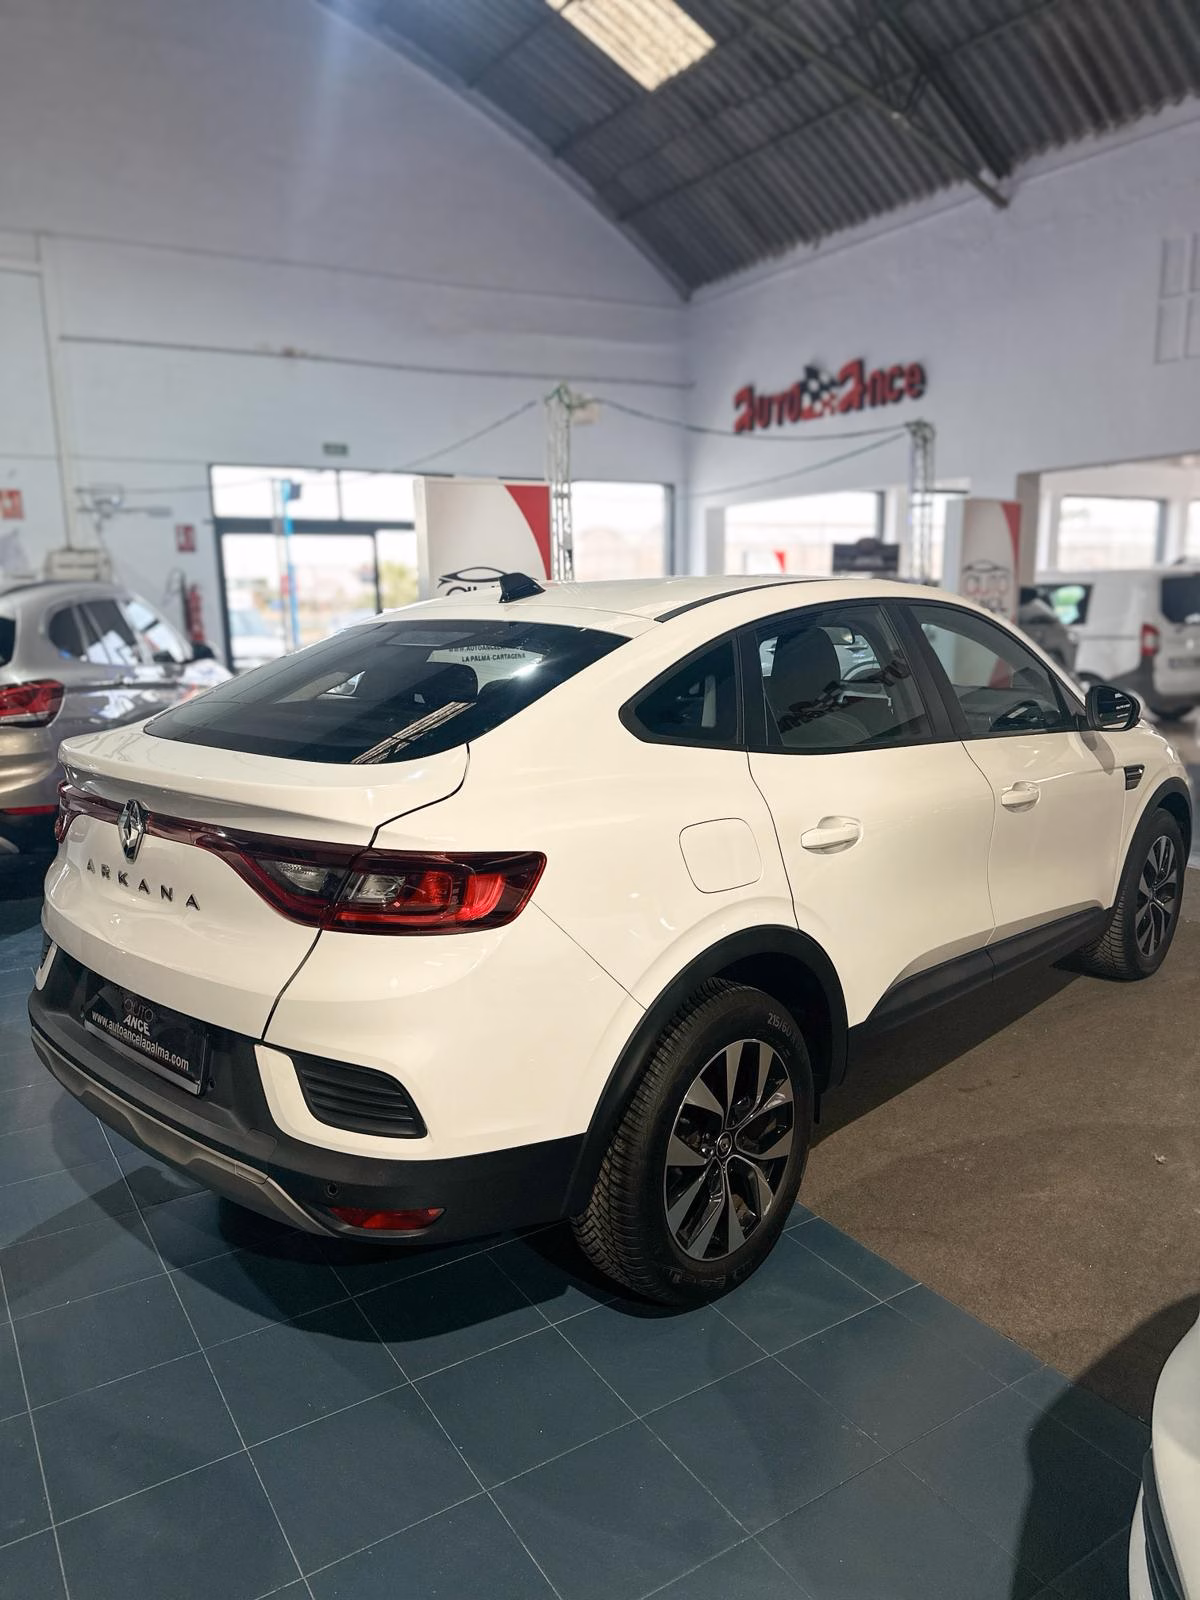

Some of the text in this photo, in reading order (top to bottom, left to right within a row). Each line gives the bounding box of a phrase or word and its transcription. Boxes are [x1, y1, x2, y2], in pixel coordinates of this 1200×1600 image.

[461, 655, 470, 663] LA
[86, 859, 201, 912] ARKANA
[123, 1014, 151, 1037] ANCE
[767, 1012, 792, 1037] 215/60
[91, 1010, 190, 1072] www.autoancelapalma.com
